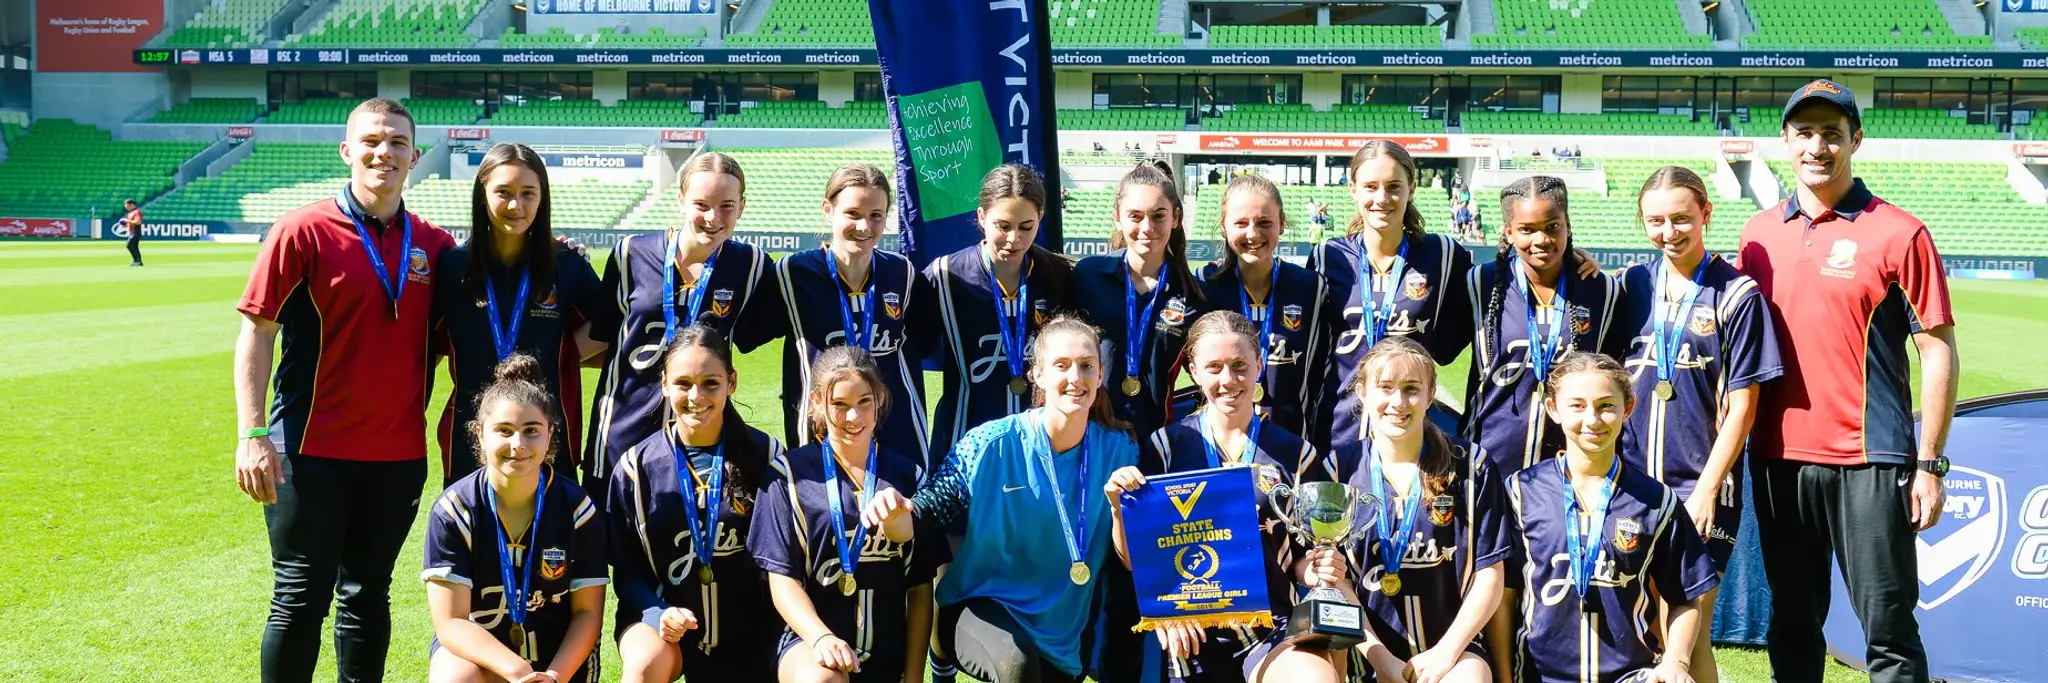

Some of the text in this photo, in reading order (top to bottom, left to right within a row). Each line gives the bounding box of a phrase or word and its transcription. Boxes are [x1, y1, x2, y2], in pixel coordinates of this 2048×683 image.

[556, 0, 691, 12] HOME OF MELBOURNE VICTORY
[140, 52, 169, 62] 12:57
[209, 51, 234, 62] MSA 5
[295, 51, 301, 62] 2
[318, 51, 342, 62] 90:00
[358, 51, 408, 62] metricon
[430, 51, 480, 62] metricon
[502, 51, 554, 62] metricon
[576, 51, 628, 62] metricon
[652, 52, 704, 63] metricon
[728, 52, 781, 63] metricon
[805, 52, 860, 63] metricon
[1128, 53, 1186, 64] metricon
[1211, 53, 1270, 64] metricon
[1296, 53, 1356, 64] metricon
[1382, 53, 1443, 65] metricon
[1470, 53, 1532, 65] metricon
[1559, 53, 1622, 65] metricon
[1650, 54, 1713, 66] metricon
[1741, 54, 1805, 66] metricon
[1834, 54, 1898, 66] metricon
[1927, 54, 1993, 67] metricon
[1253, 138, 1290, 147] WELCOME
[1292, 138, 1301, 147] TO
[1303, 138, 1324, 147] AAMI
[1325, 138, 1345, 147] PARK
[912, 135, 973, 162] Through
[563, 155, 625, 167] metricon
[919, 160, 962, 185] Sport
[141, 224, 207, 237] HYUNDAI
[1492, 334, 1574, 387] Jts
[1166, 487, 1192, 497] VICTORIA
[1172, 519, 1213, 534] STATE
[1157, 528, 1232, 549] CHAMPIONS
[1541, 546, 1622, 606] Jts
[1182, 582, 1220, 592] FOOTBALL
[1157, 589, 1248, 602] PREMIER LEAGUE GIRLS
